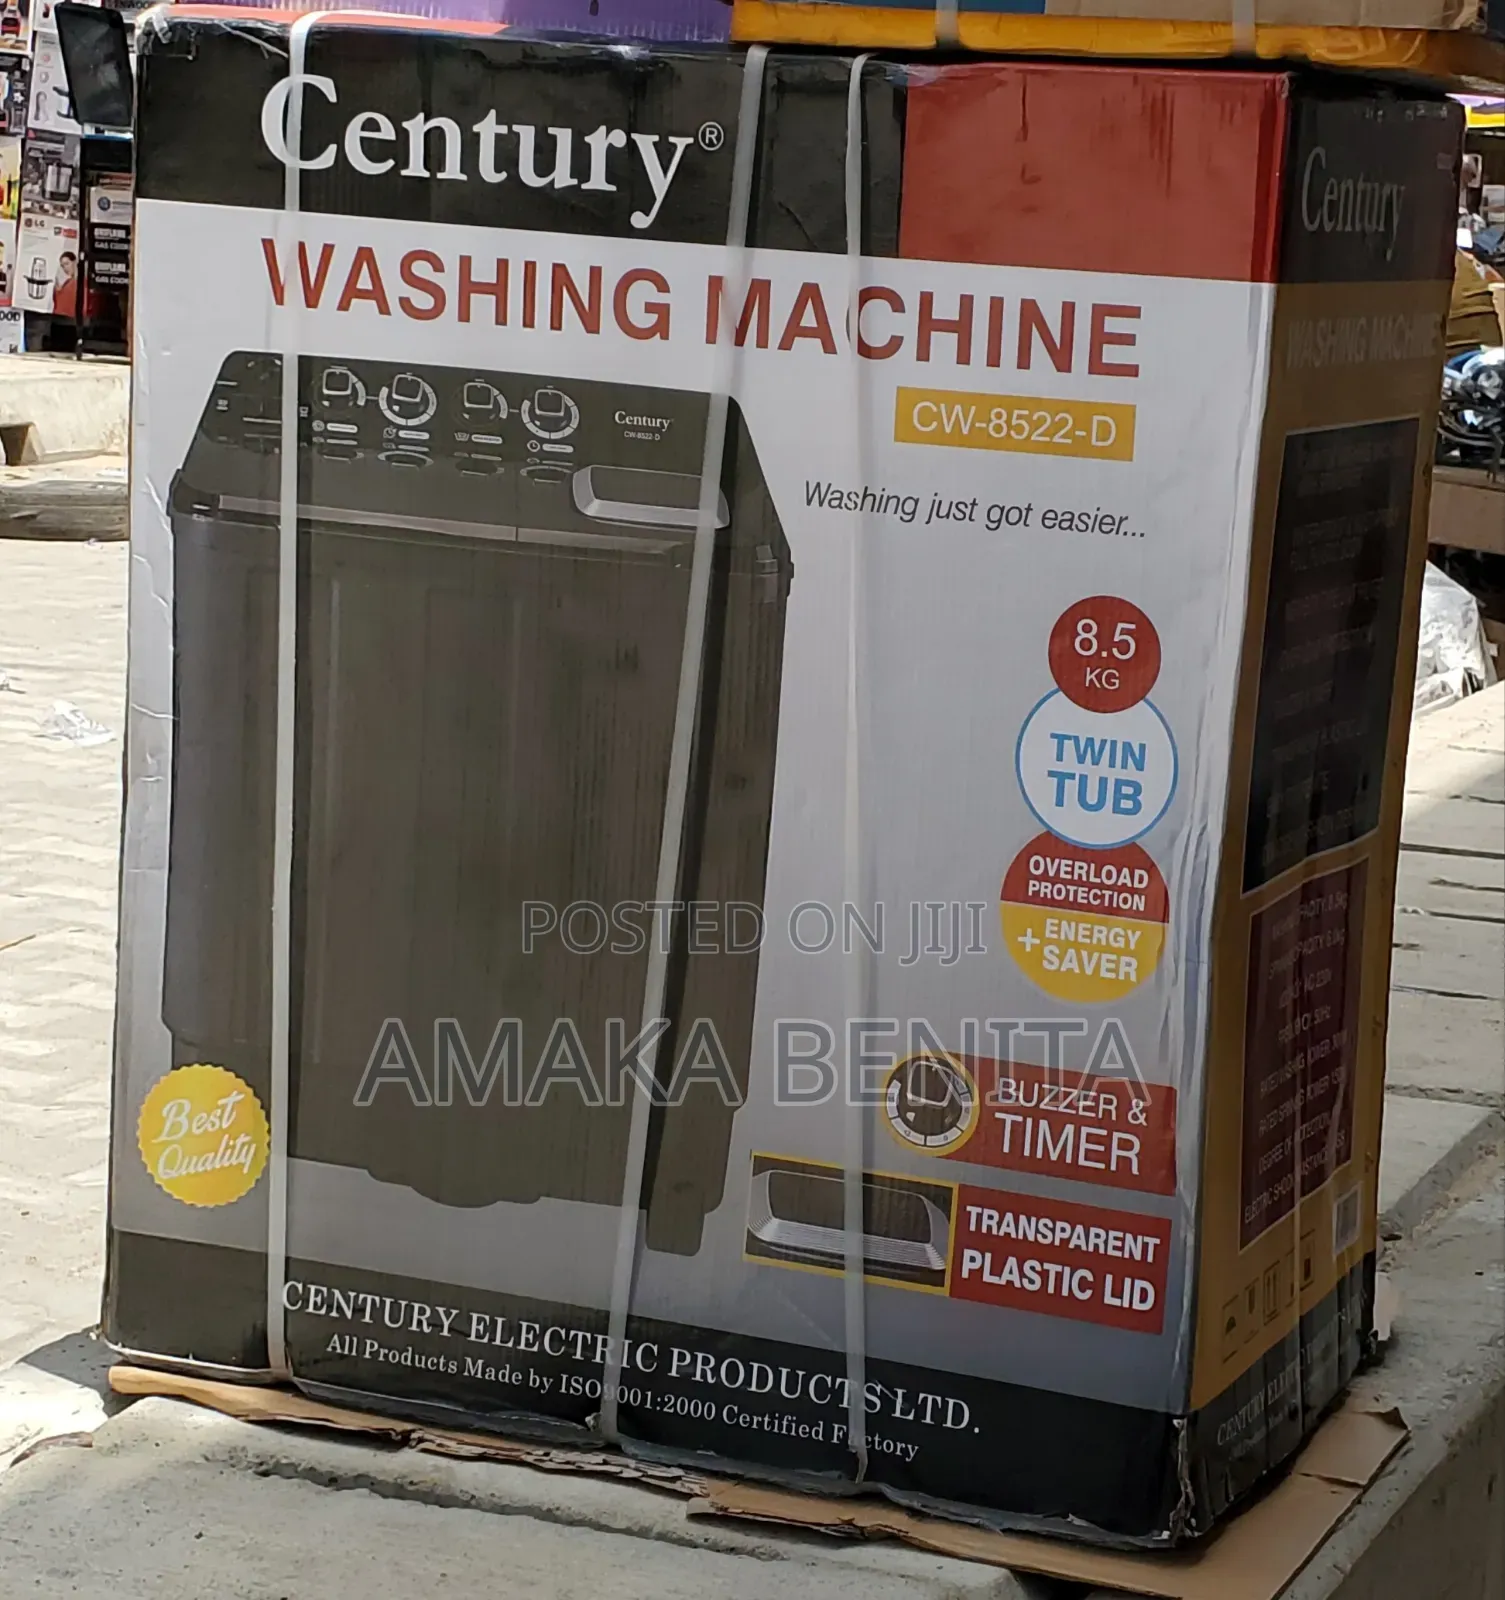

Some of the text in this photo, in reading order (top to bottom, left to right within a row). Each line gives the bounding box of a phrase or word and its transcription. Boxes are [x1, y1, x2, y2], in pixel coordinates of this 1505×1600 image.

[1302, 146, 1405, 262] Century
[261, 238, 1143, 378] WASHING MACHINE
[614, 410, 672, 431] Century
[912, 401, 1117, 448] CW-8522-D
[804, 479, 1146, 538] Washing just got easier...
[1074, 618, 1136, 660] 8.5
[1085, 667, 1120, 690] KG
[1049, 732, 1147, 772] TWIN
[1047, 769, 1143, 816] TUB
[1027, 879, 1146, 912] PROTECTION
[1028, 854, 1149, 890] OVERLOAD
[1045, 917, 1141, 951] ENERGY
[1042, 944, 1138, 982] SAVER
[152, 1090, 245, 1144] Best
[998, 1077, 1148, 1126] BUZZER &
[157, 1133, 256, 1179] Quality
[994, 1112, 1141, 1175] TIMER
[966, 1205, 1160, 1264] TRANSPARENT
[961, 1249, 1156, 1311] PLASTIC LID
[282, 1281, 980, 1433] CENTURY ELECTRIC PRODUCTS LTD.
[326, 1332, 359, 1357] All
[362, 1338, 459, 1375] Products
[463, 1357, 523, 1386] Made
[528, 1366, 554, 1394] by
[559, 1373, 716, 1421] ISO001:2000
[722, 1404, 825, 1443] Certified
